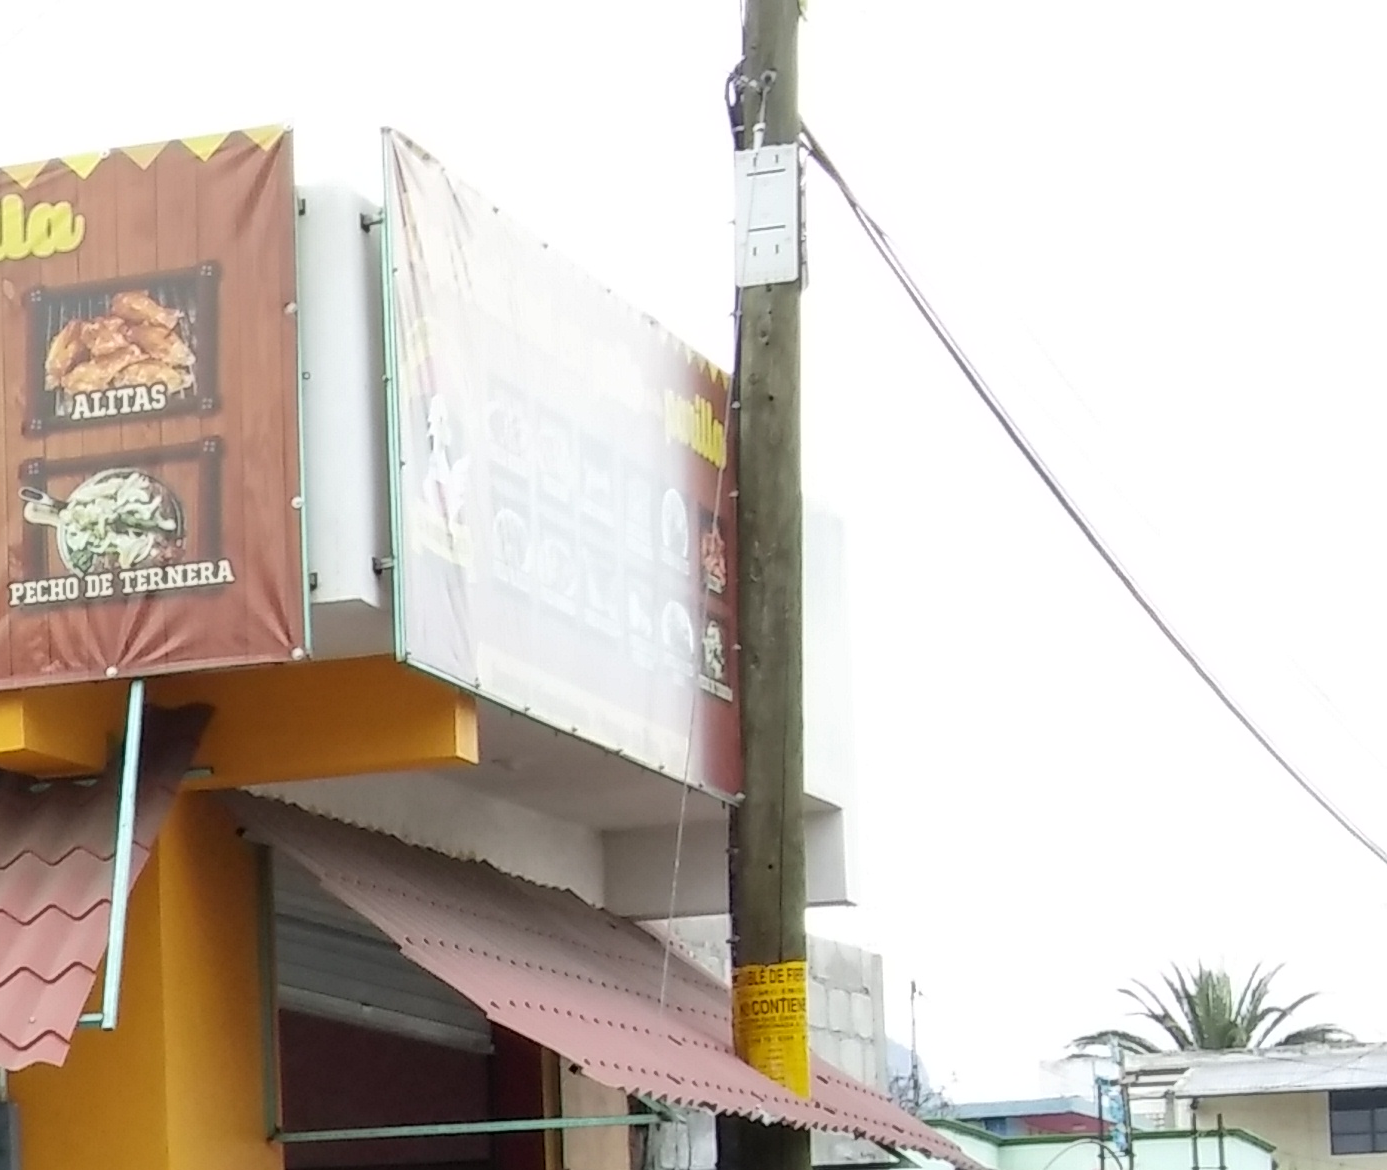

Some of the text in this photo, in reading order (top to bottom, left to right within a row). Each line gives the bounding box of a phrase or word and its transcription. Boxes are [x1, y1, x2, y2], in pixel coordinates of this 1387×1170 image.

[72, 384, 167, 420] ALITAS
[10, 560, 235, 607] PECHO DE TERNERA
